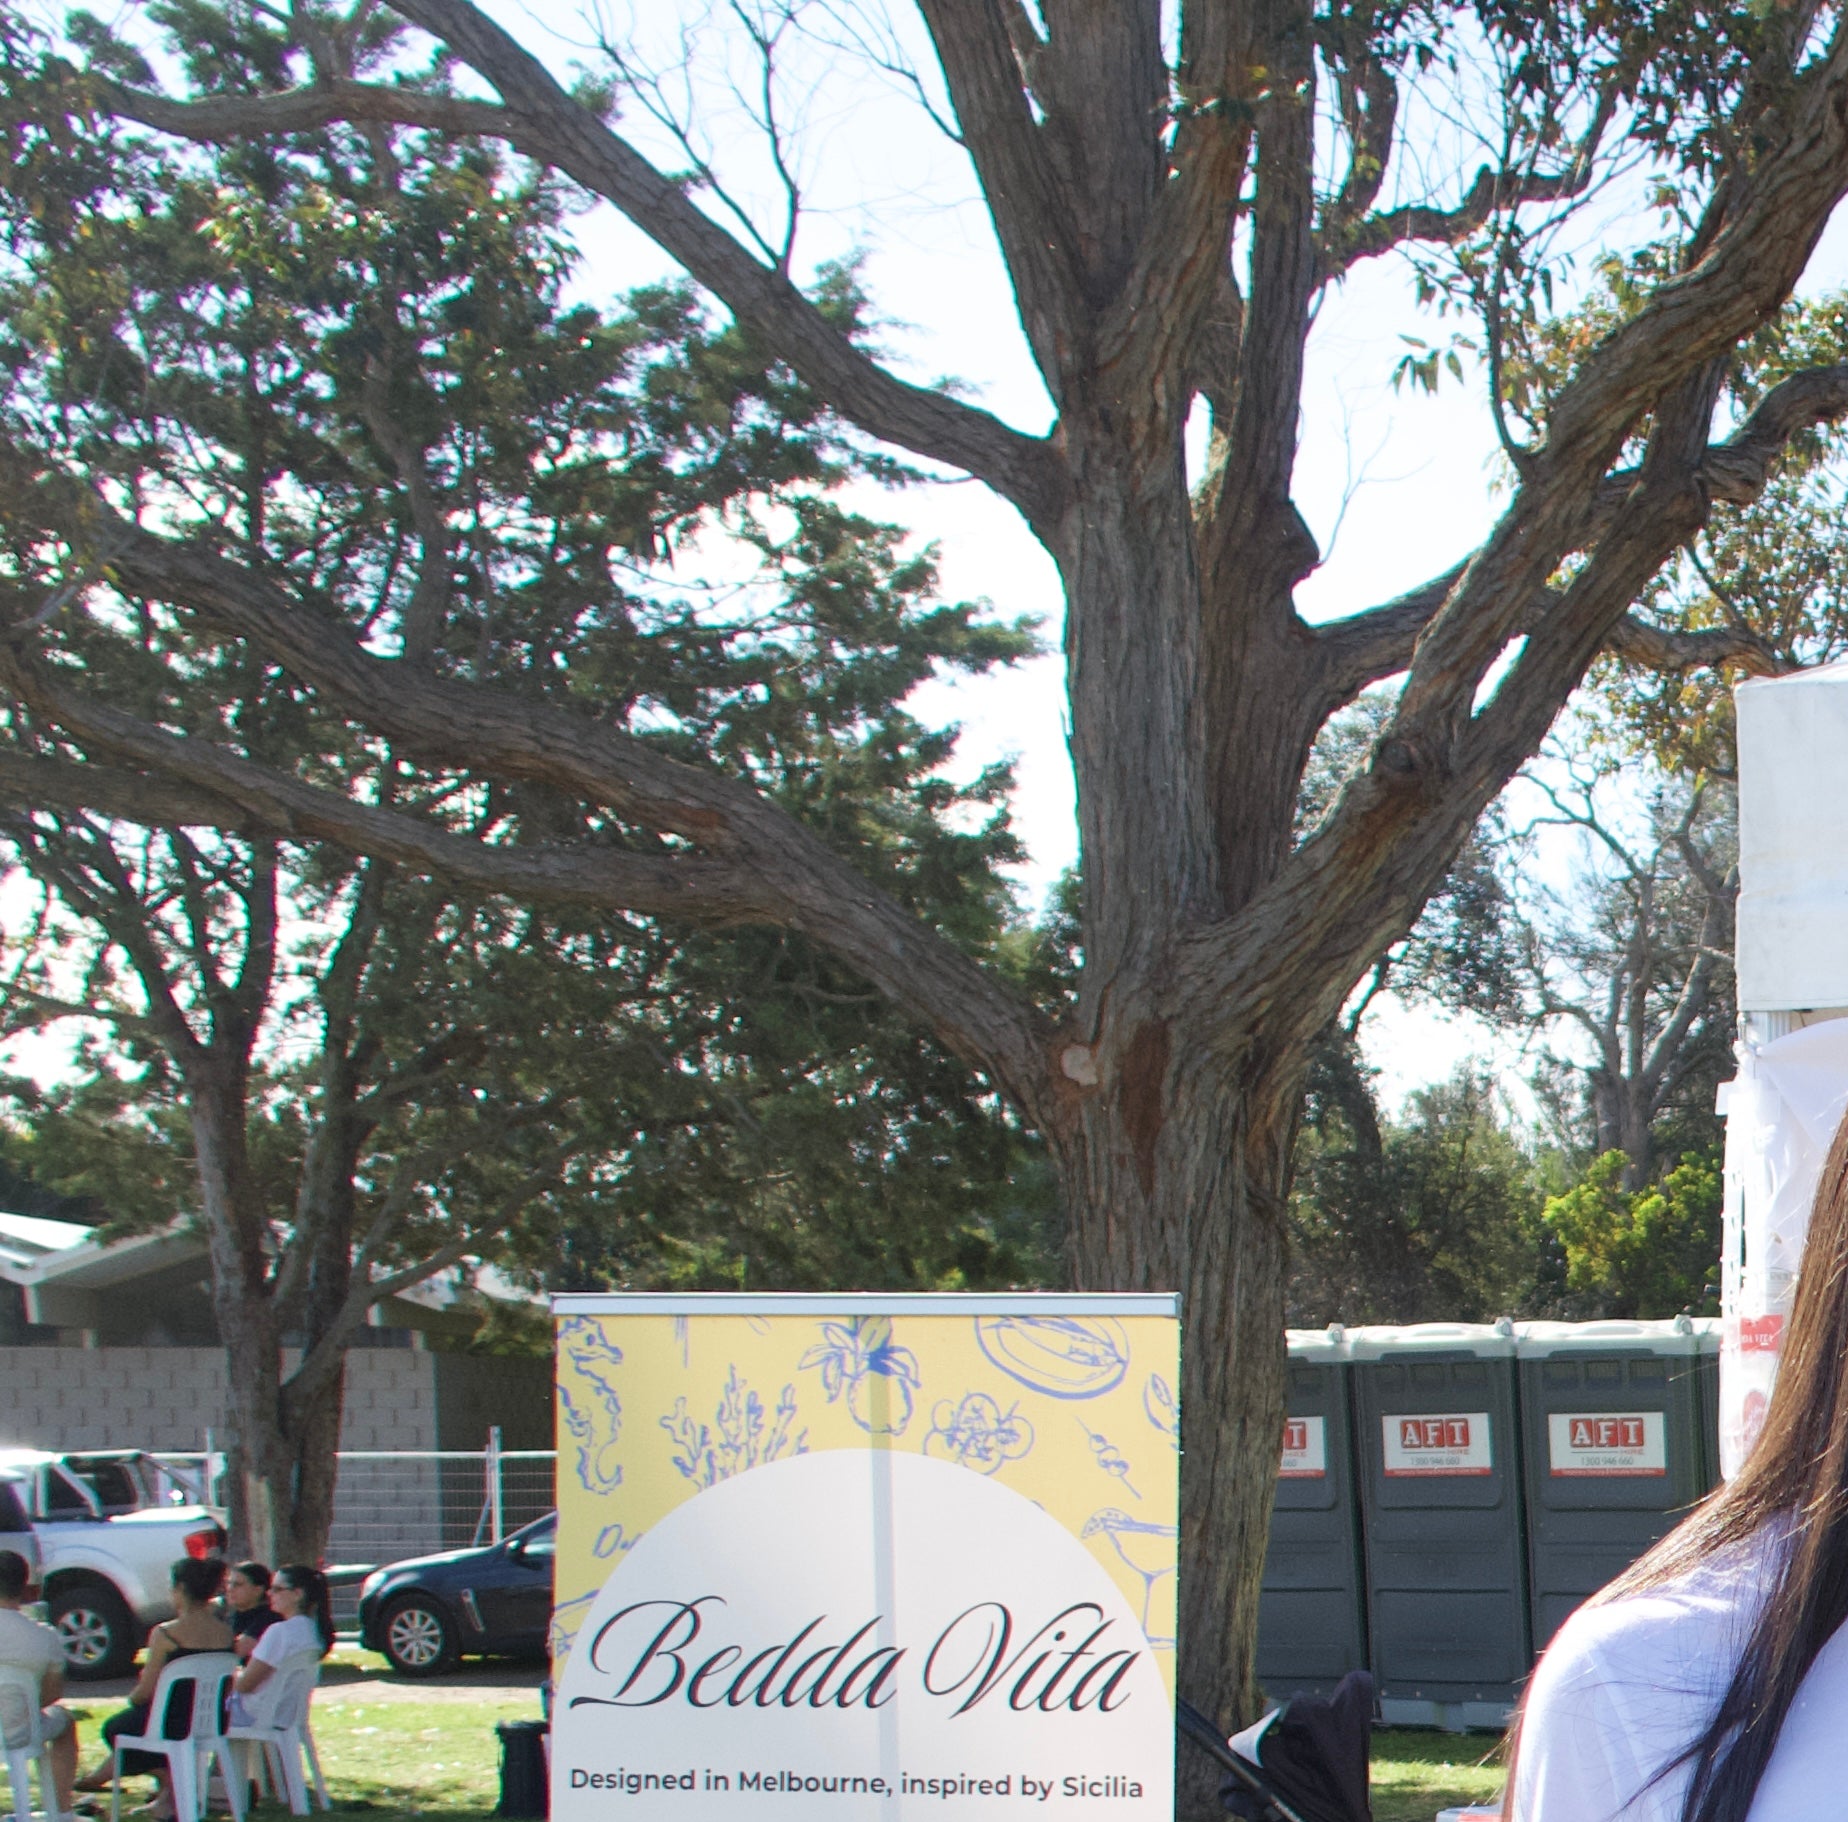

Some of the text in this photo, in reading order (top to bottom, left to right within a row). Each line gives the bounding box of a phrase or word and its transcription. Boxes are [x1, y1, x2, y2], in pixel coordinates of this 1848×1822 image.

[1402, 1420, 1467, 1446] AFT
[1571, 1419, 1641, 1446] AFT
[570, 1595, 1144, 1719] Bedda Vita
[568, 1765, 1144, 1803] Designed in Melbourne, inspired by Sicilia
